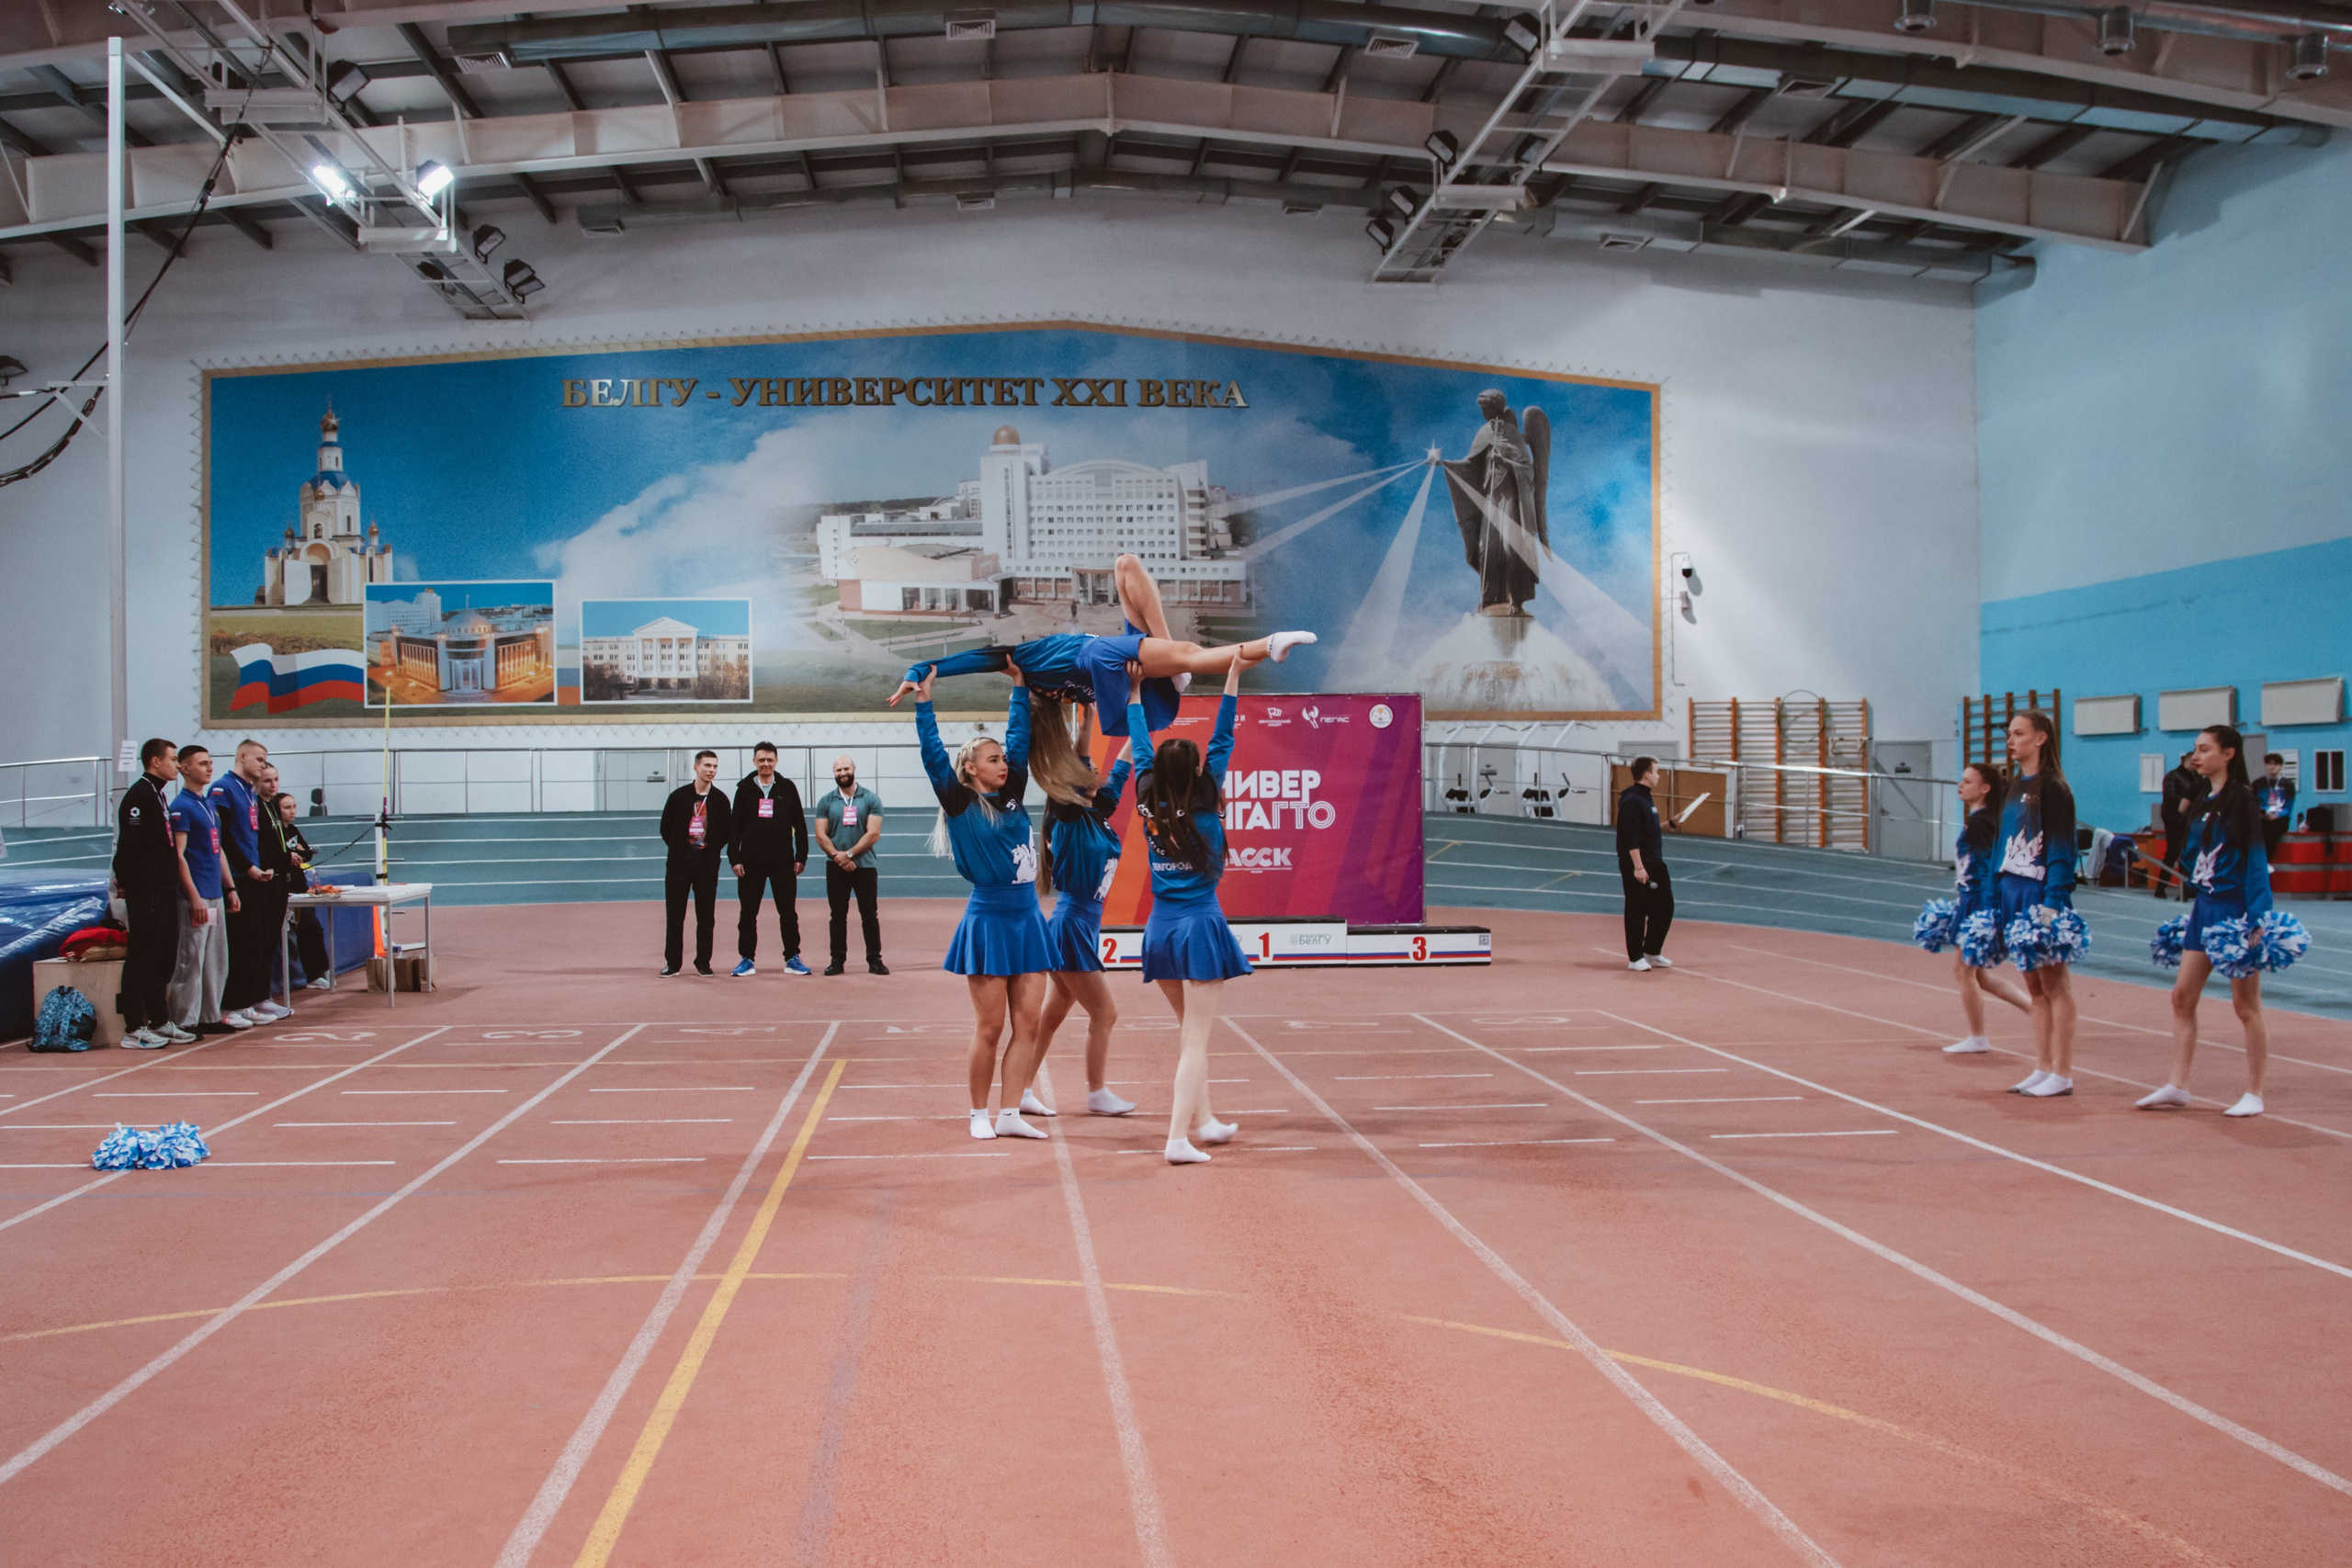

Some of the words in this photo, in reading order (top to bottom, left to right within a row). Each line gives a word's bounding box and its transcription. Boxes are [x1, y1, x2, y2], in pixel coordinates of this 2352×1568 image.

[560, 378, 699, 408] БЕЛГУ
[729, 378, 1044, 407] УНИВЕРСИТЕТ
[1136, 378, 1249, 409] ВЕКА
[1102, 938, 1117, 964] 2
[1259, 932, 1271, 957] 1
[1412, 936, 1427, 962] 3
